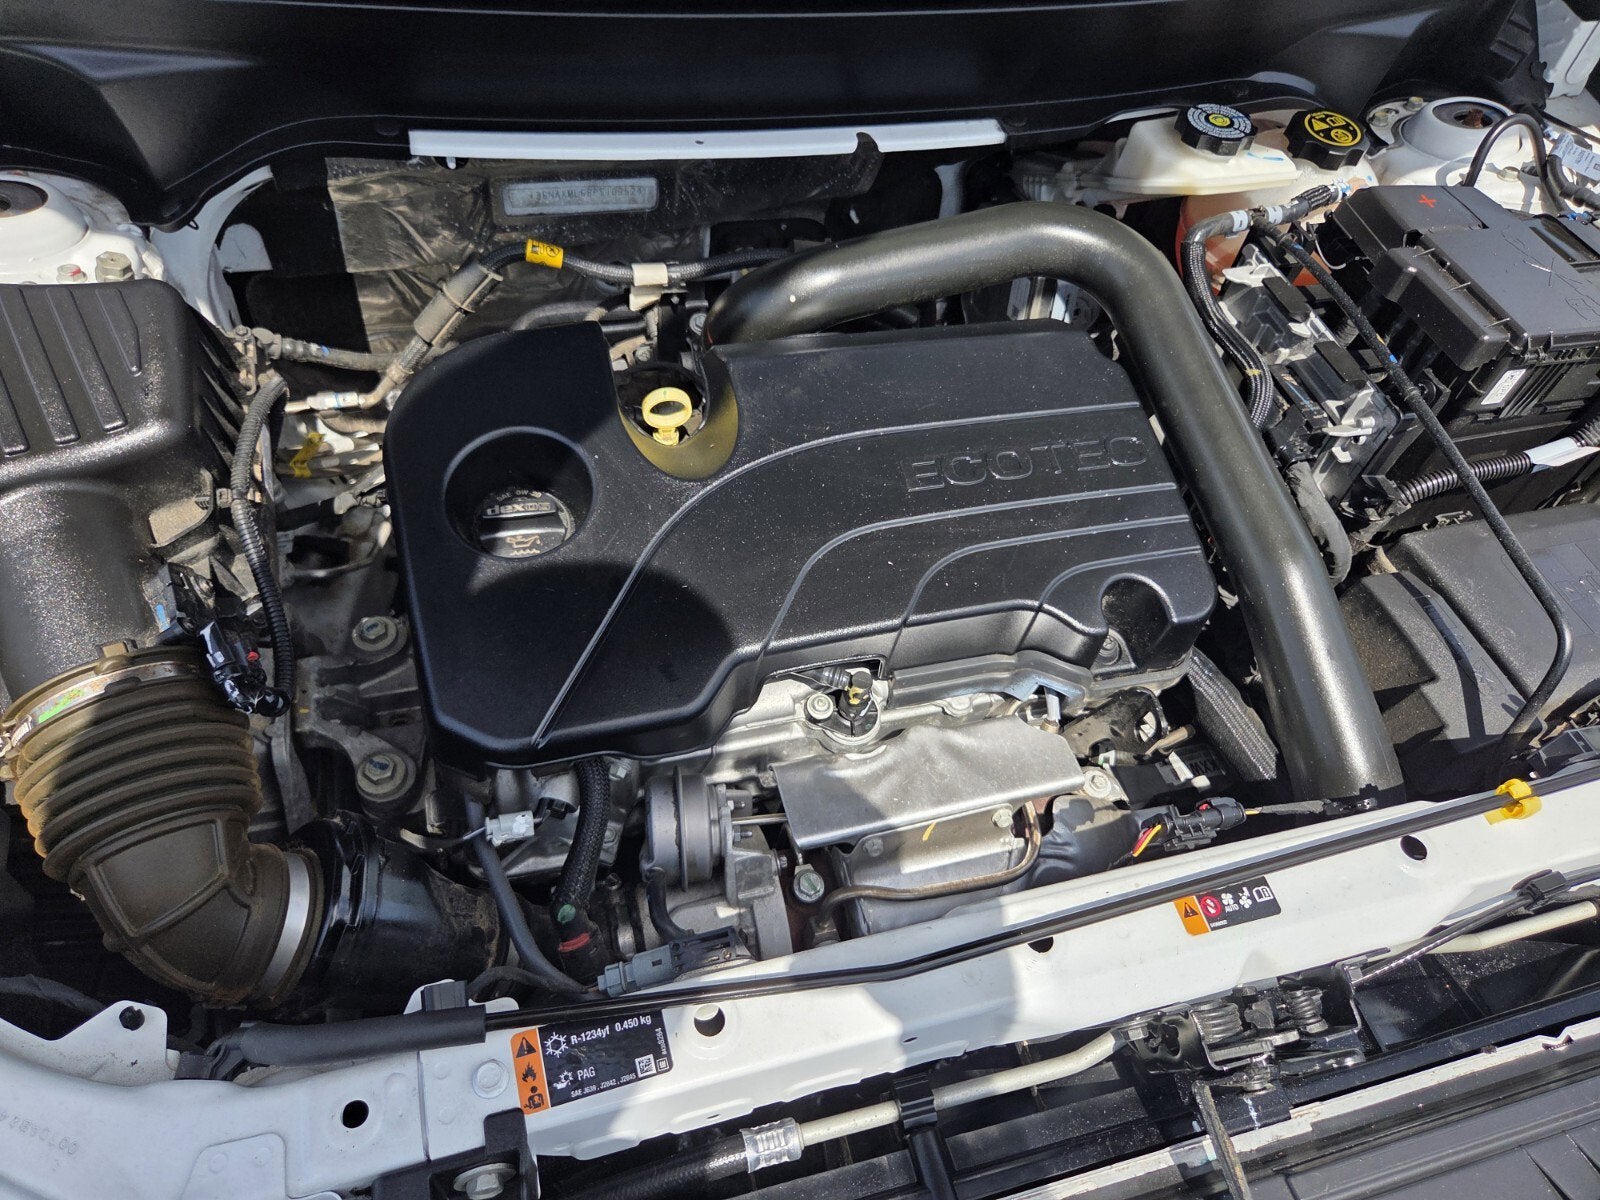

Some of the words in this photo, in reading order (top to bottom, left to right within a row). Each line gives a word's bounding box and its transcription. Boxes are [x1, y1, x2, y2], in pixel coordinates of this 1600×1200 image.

[902, 436, 1148, 492] ECOTEC
[486, 502, 550, 515] dexos
[1224, 903, 1239, 913] AUTO
[570, 1025, 610, 1044] R-1234yf
[615, 1018, 638, 1032] 0.450
[640, 1014, 652, 1025] kg
[577, 1066, 595, 1081] PAG
[571, 1088, 582, 1098] SAE
